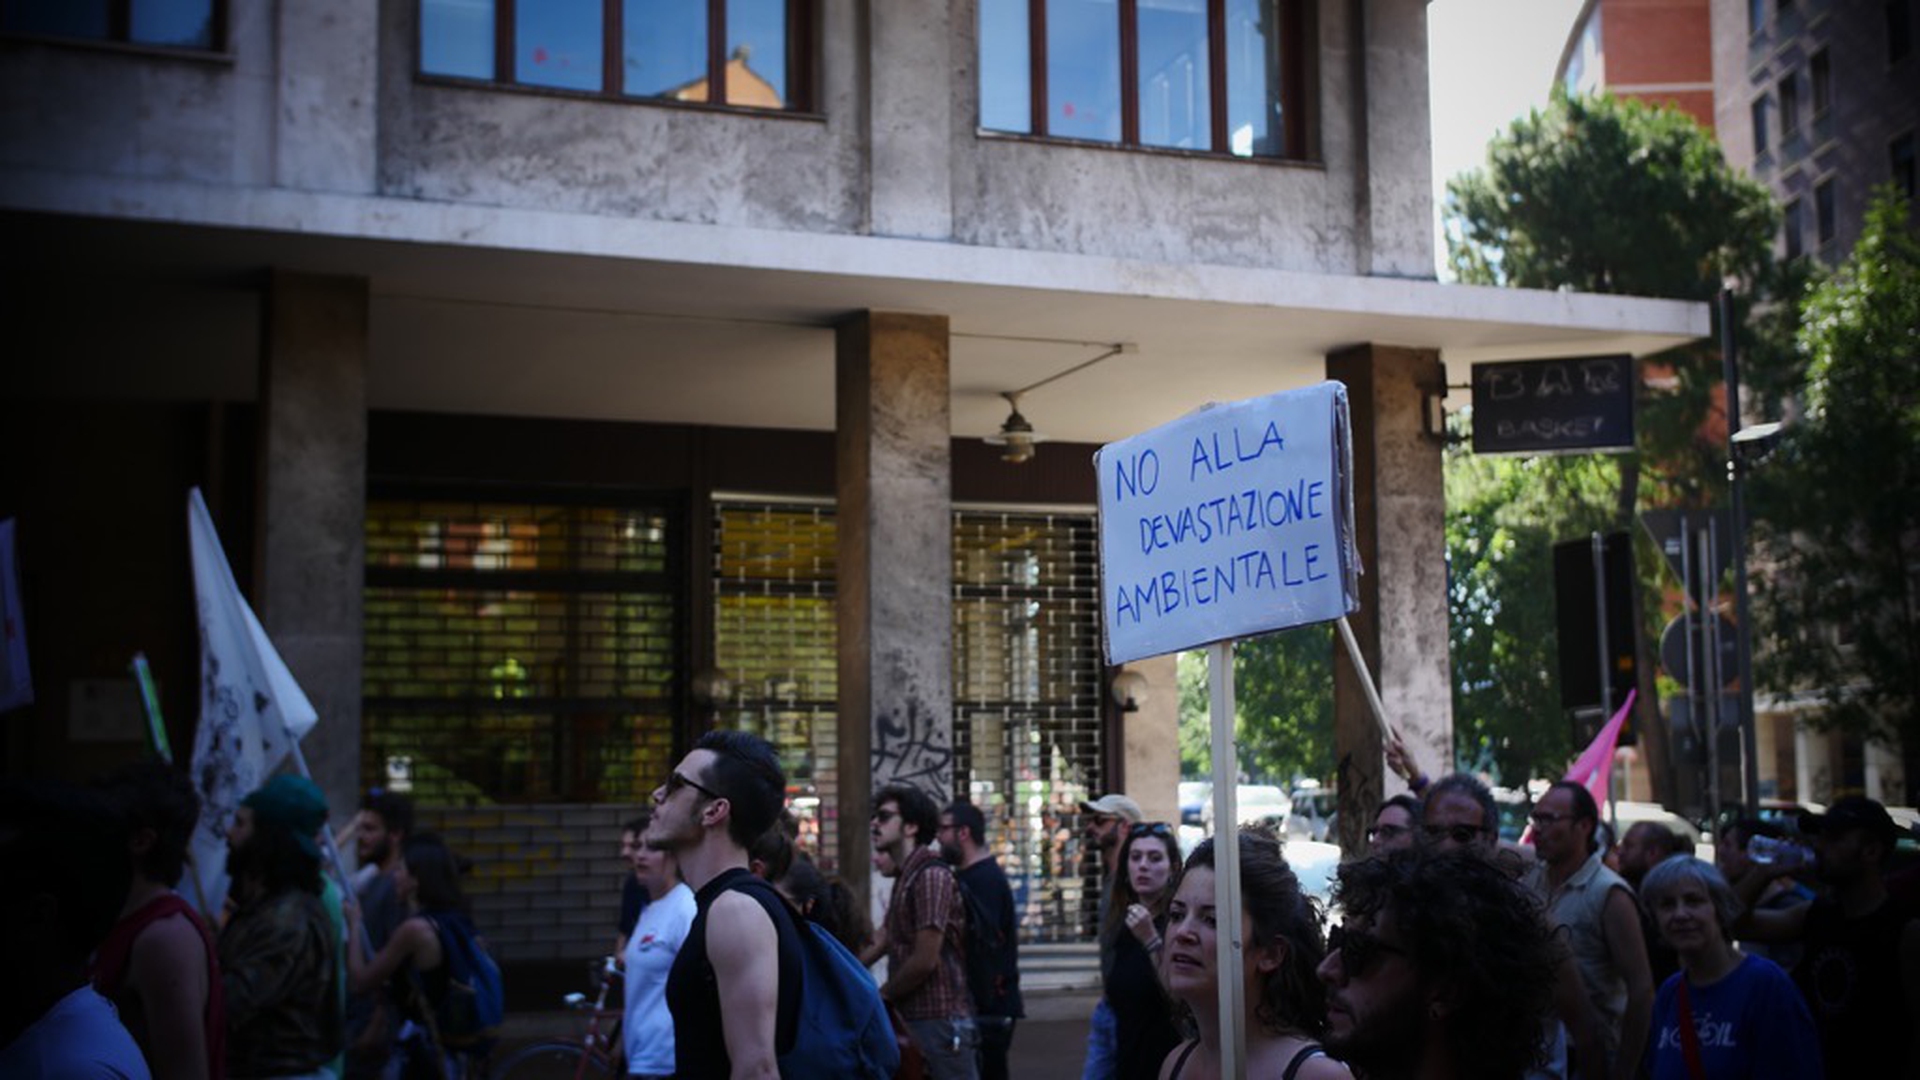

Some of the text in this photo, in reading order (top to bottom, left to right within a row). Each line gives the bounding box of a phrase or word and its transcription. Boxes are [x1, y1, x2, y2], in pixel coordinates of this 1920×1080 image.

[1481, 359, 1620, 400] BAR
[1116, 420, 1284, 501] NO ALLA
[1497, 415, 1605, 440] BASKET
[1139, 478, 1323, 555] DEVASTAZIONE
[1116, 544, 1328, 626] AMBIENTALE
